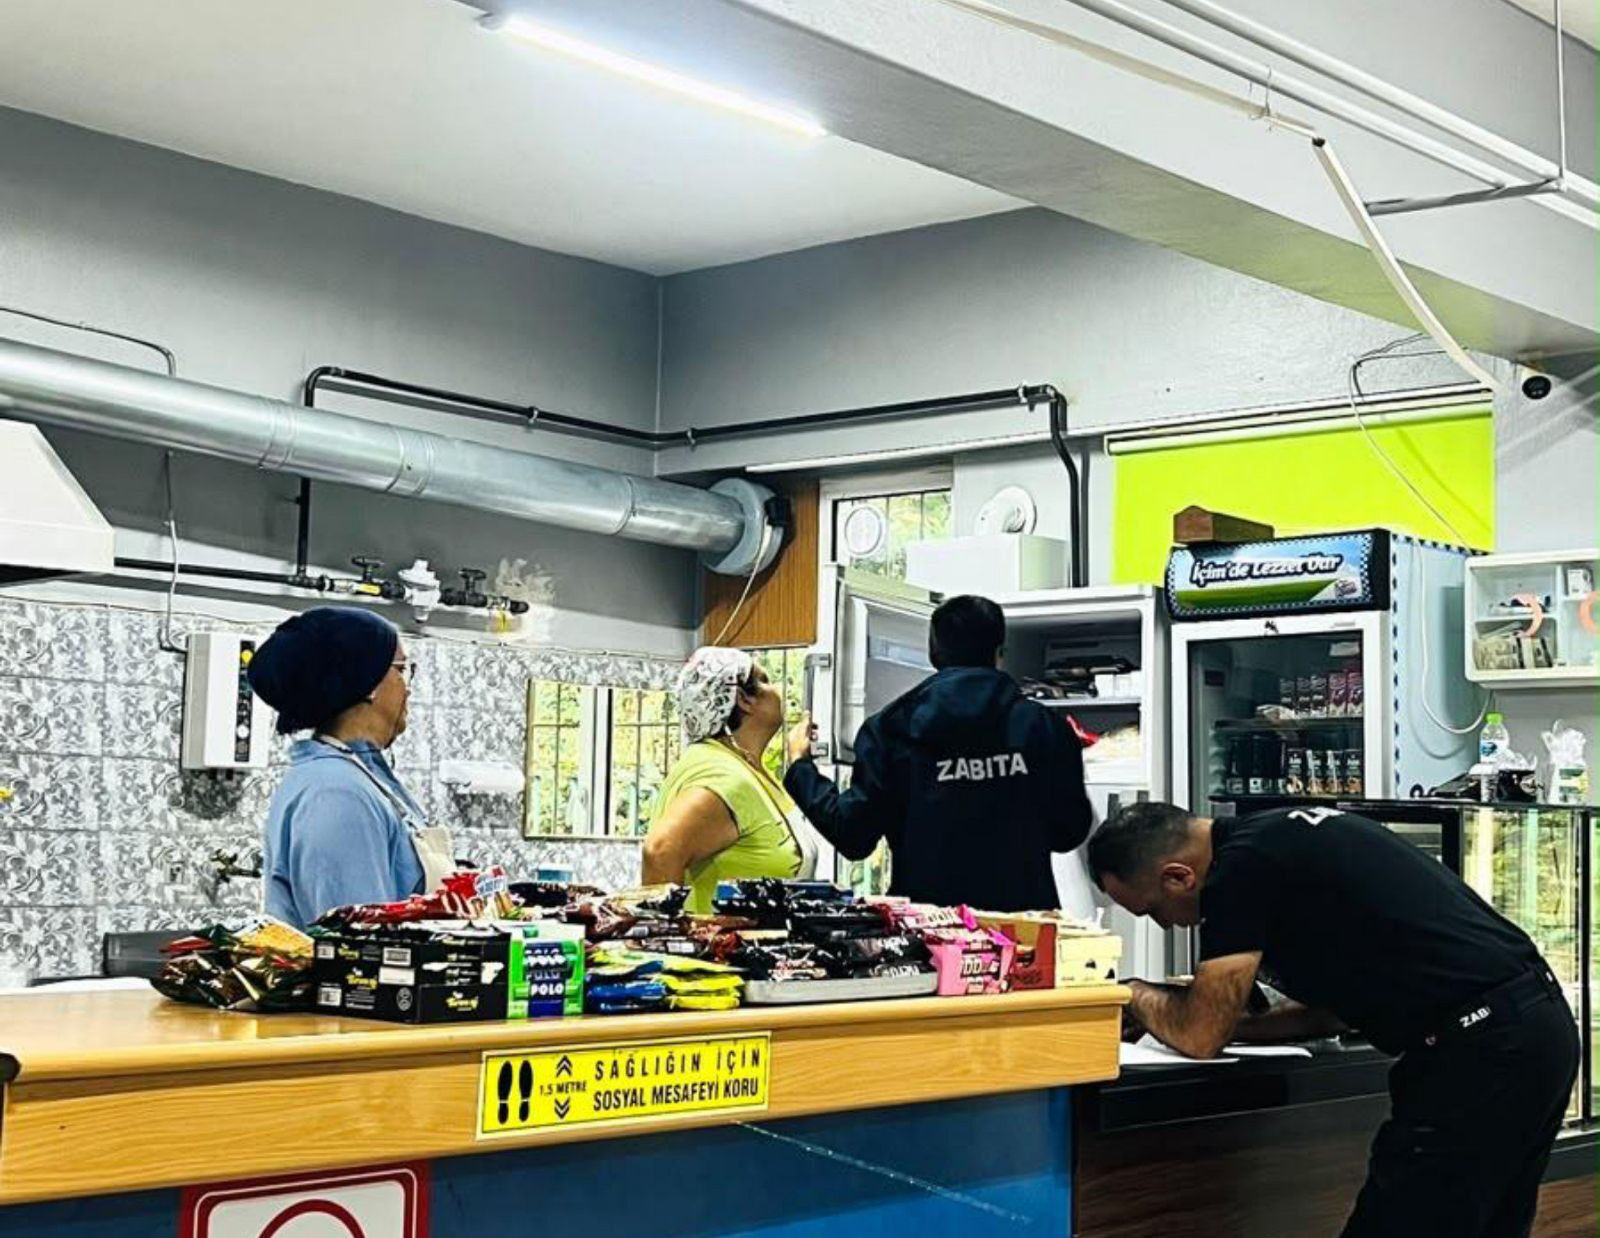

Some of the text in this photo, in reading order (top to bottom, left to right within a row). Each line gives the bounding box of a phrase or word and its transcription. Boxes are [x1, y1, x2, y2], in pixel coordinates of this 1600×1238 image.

[936, 752, 1028, 781] ZABITA
[530, 983, 565, 997] POLO
[594, 1046, 761, 1081] SAĞLIĞIN İÇİN
[556, 1080, 587, 1094] METRE
[593, 1076, 759, 1111] SOSYAL MESAFEYİ KORU
